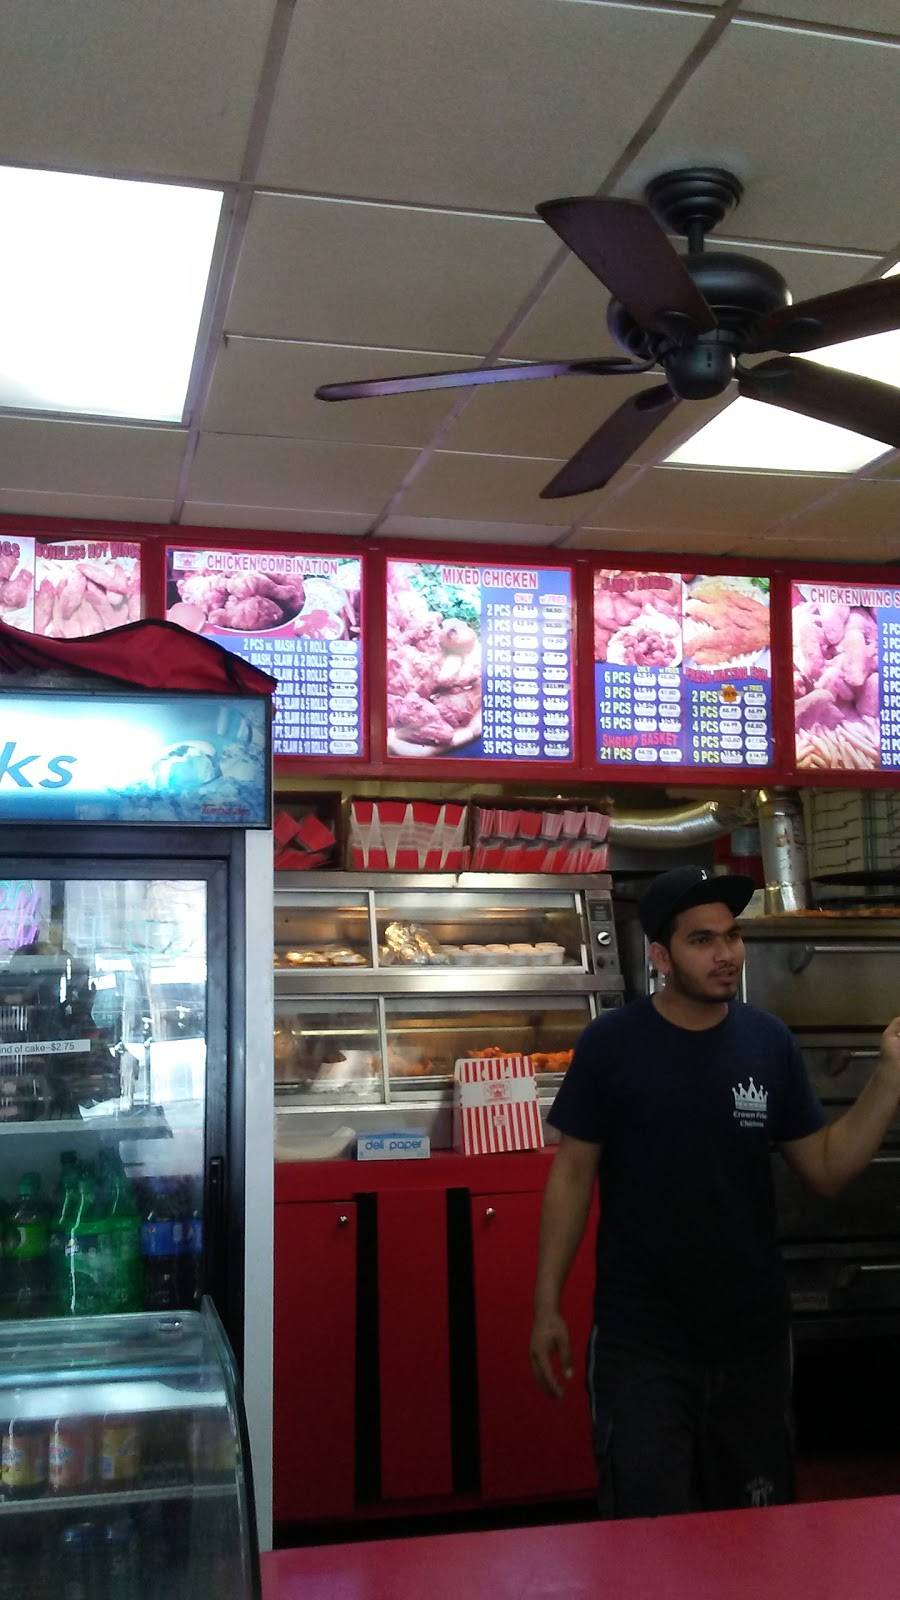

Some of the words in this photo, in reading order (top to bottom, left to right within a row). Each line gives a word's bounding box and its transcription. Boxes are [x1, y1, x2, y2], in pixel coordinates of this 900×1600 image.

[207, 554, 256, 571] CHICKEN
[260, 557, 338, 575] COMBINATION
[442, 568, 480, 585] MIXED
[484, 571, 537, 588] CHICKEN
[810, 588, 859, 604] CHICKEN
[862, 590, 891, 606] WING
[487, 604, 493, 616] 2
[494, 604, 511, 616] PCS
[494, 619, 511, 632] PCS
[882, 623, 888, 635] 2
[243, 638, 249, 650] 2
[250, 638, 264, 651] PCS
[494, 634, 511, 646] PCS
[882, 638, 888, 649] 3
[300, 655, 306, 667] 2
[494, 649, 511, 662] PCS
[882, 652, 888, 664] 4
[494, 665, 511, 677] PCS
[604, 671, 610, 683] 6
[613, 671, 631, 684] PCS
[882, 666, 888, 678] 5
[487, 680, 493, 692] 9
[494, 680, 512, 693] PCS
[604, 686, 610, 698] 9
[613, 687, 631, 699] PCS
[883, 680, 889, 692] 6
[483, 695, 493, 708] 12
[495, 695, 512, 708] PCS
[691, 690, 698, 702] 2
[700, 690, 718, 703] PCS
[883, 695, 889, 707] 9
[600, 701, 611, 714] 12
[613, 702, 631, 714] PCS
[692, 705, 698, 717] 3
[700, 705, 718, 718] PCS
[483, 710, 493, 723] 15
[495, 710, 512, 723] PCS
[880, 709, 889, 721] 12
[600, 716, 611, 729] 15
[613, 717, 631, 730] PCS
[692, 720, 699, 732] 4
[701, 721, 719, 733] PCS
[483, 726, 493, 738] 21
[495, 726, 512, 738] PCS
[881, 724, 890, 736] 15
[603, 734, 638, 748] SHRIMP
[641, 732, 677, 746] BASKET
[692, 735, 699, 748] 6
[701, 736, 719, 748] PCS
[881, 738, 890, 750] 21
[483, 741, 494, 754] 35
[496, 741, 512, 754] PCS
[600, 747, 610, 759] 21
[613, 747, 632, 760] PCS
[693, 750, 699, 763] 9
[701, 751, 720, 763] PCS
[882, 753, 891, 765] 35
[0, 741, 78, 789] ks
[14, 1044, 23, 1054] of
[365, 1139, 384, 1151] deli
[389, 1140, 422, 1152] paper
